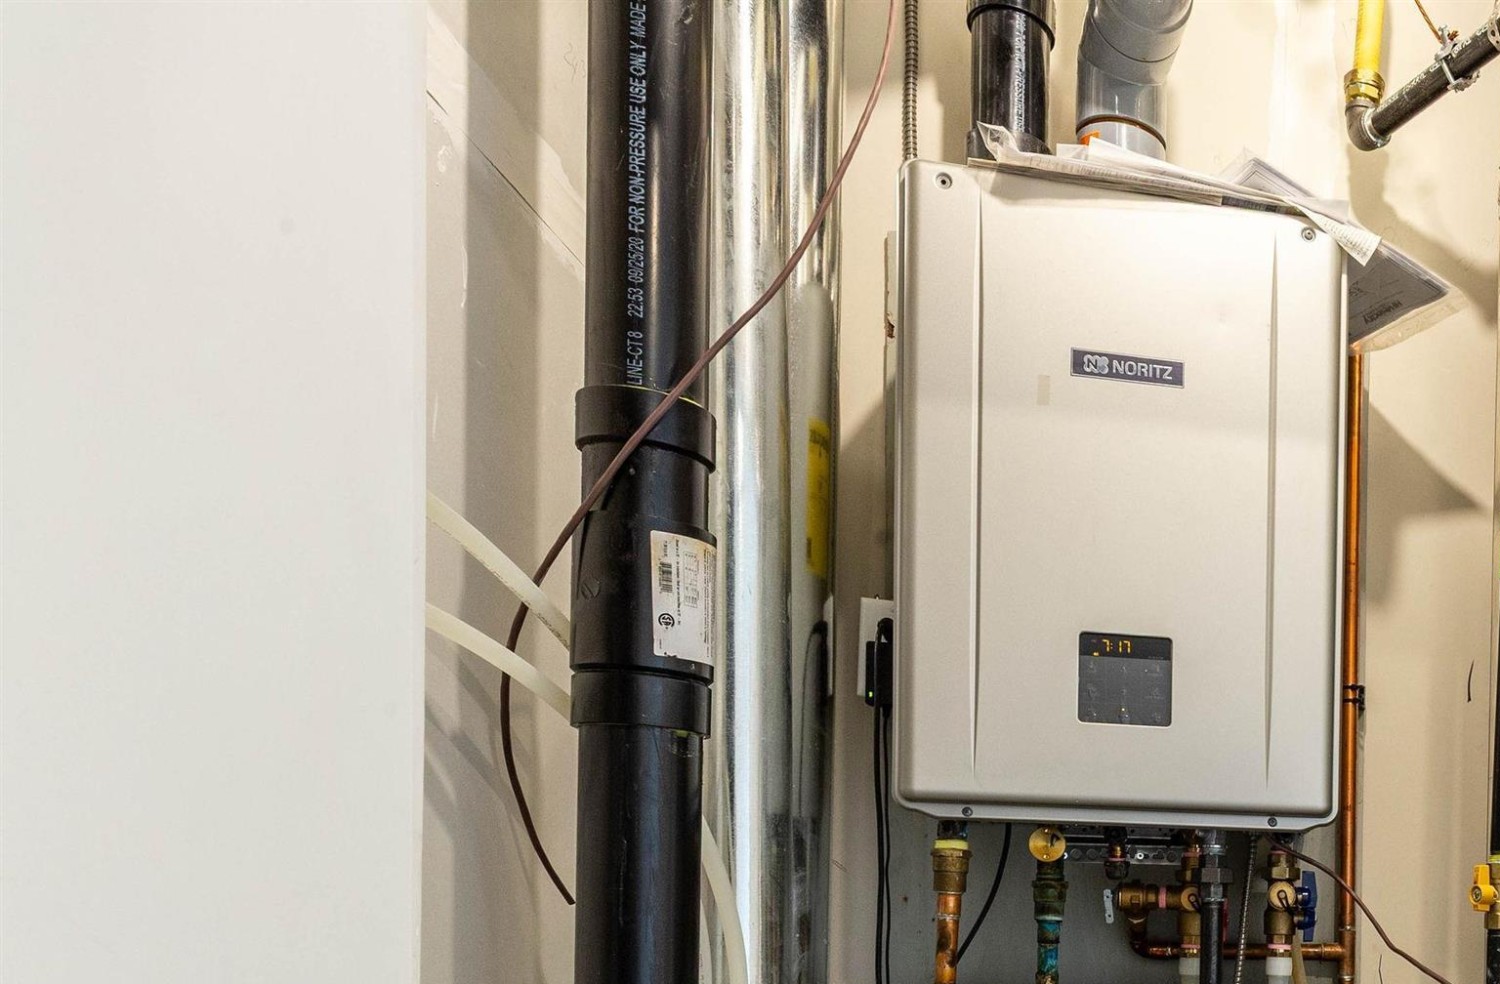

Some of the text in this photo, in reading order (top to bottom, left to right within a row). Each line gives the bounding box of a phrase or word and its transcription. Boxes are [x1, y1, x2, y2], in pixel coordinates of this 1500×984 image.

[629, 1, 647, 38] MADE
[629, 40, 647, 77] ONLY
[629, 77, 647, 103] USE
[628, 105, 647, 205] NON-PRESSURE
[628, 205, 646, 233] FOR
[627, 236, 645, 285] 09/25/20
[627, 287, 645, 319] 22:53
[1112, 359, 1173, 380] NORITZ
